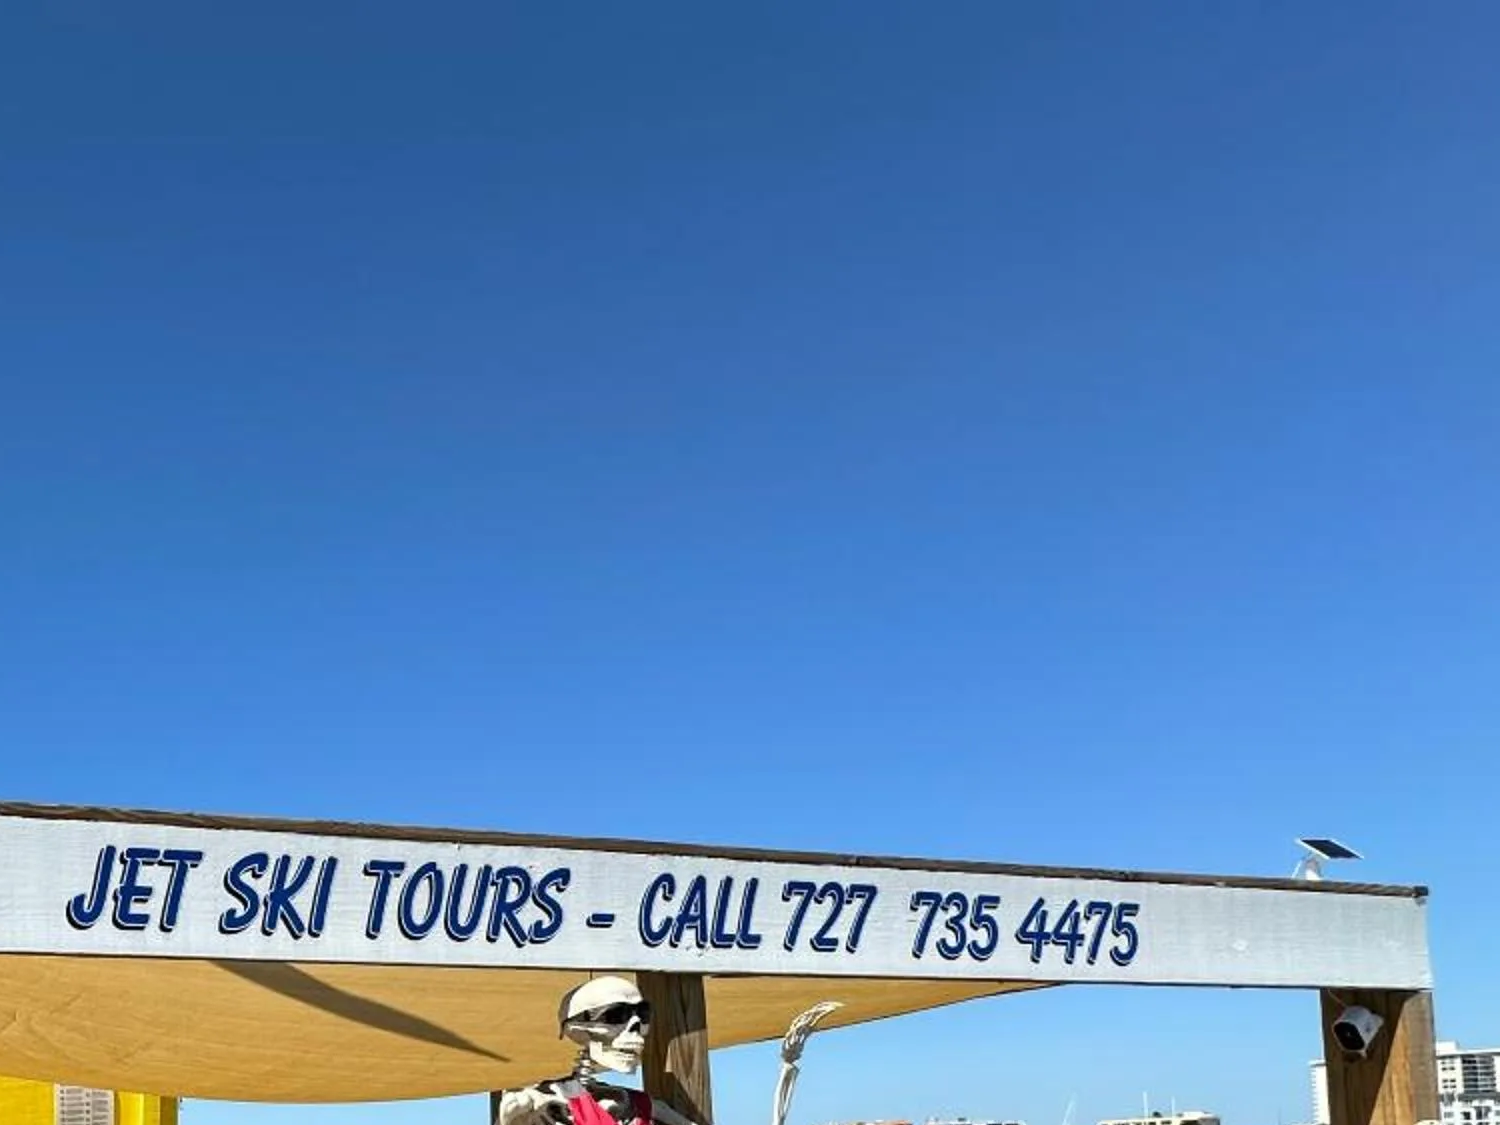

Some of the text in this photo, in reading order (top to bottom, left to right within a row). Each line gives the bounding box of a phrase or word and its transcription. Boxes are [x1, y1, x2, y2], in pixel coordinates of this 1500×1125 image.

[66, 845, 203, 932] JET
[218, 852, 338, 938] SKI
[363, 860, 571, 947] TOURS
[638, 873, 762, 948] CALL
[782, 881, 877, 953] 727
[910, 892, 1000, 960] 735
[1014, 897, 1140, 966] 4475
